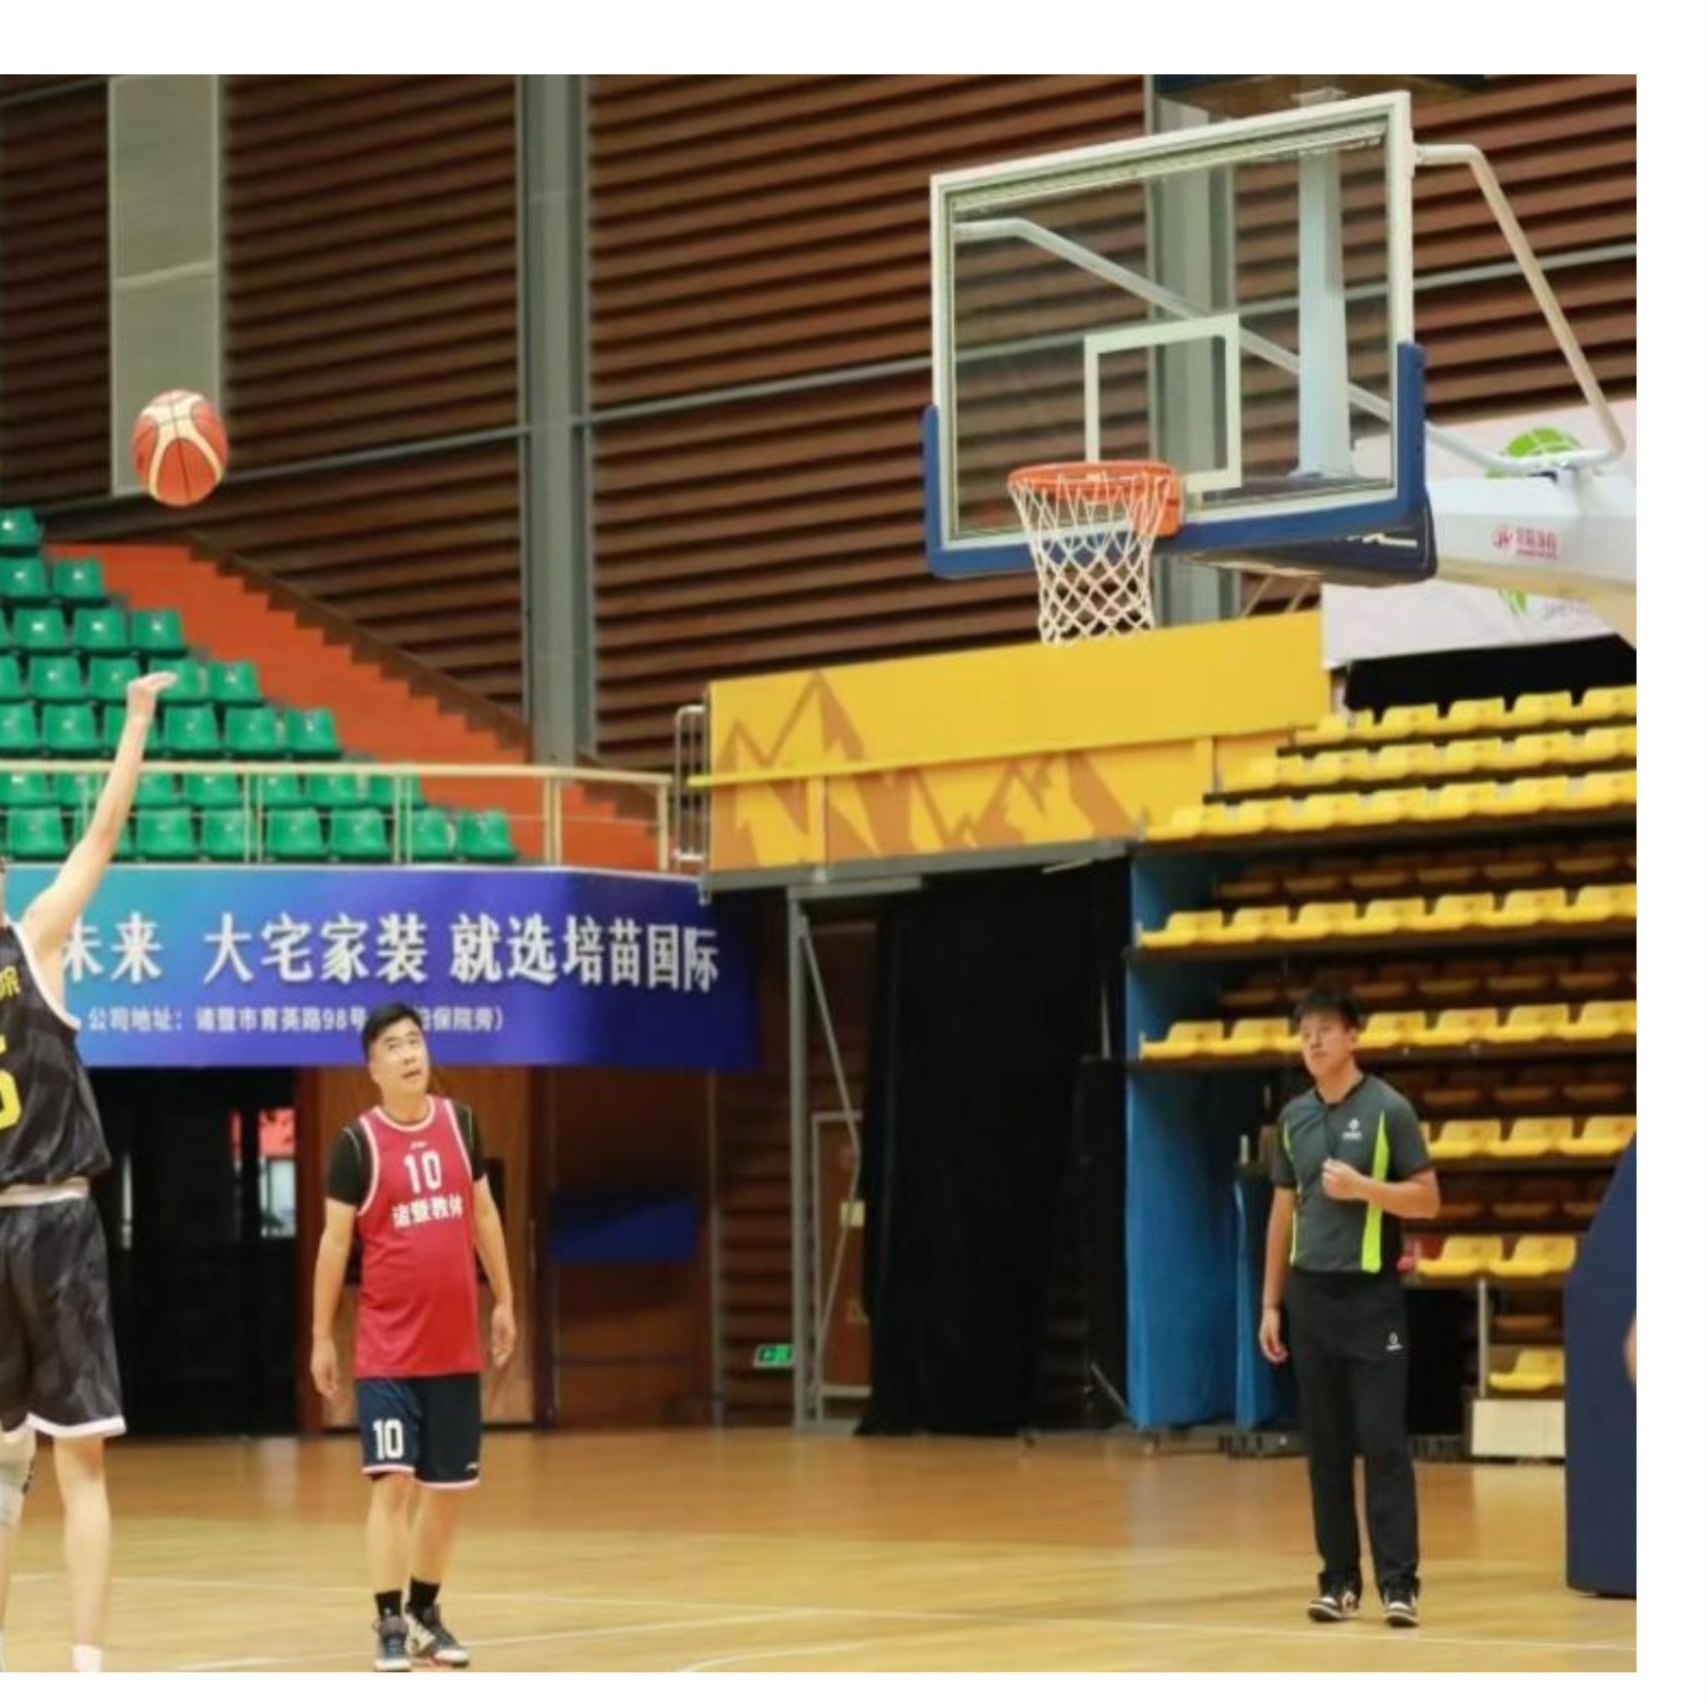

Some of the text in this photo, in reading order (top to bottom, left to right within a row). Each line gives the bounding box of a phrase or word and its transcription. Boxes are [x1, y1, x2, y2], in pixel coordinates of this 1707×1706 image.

[203, 911, 430, 985] 大宅家装
[448, 912, 720, 994] 就选培苗国际
[403, 1149, 443, 1194] 10
[373, 1417, 405, 1461] 10
